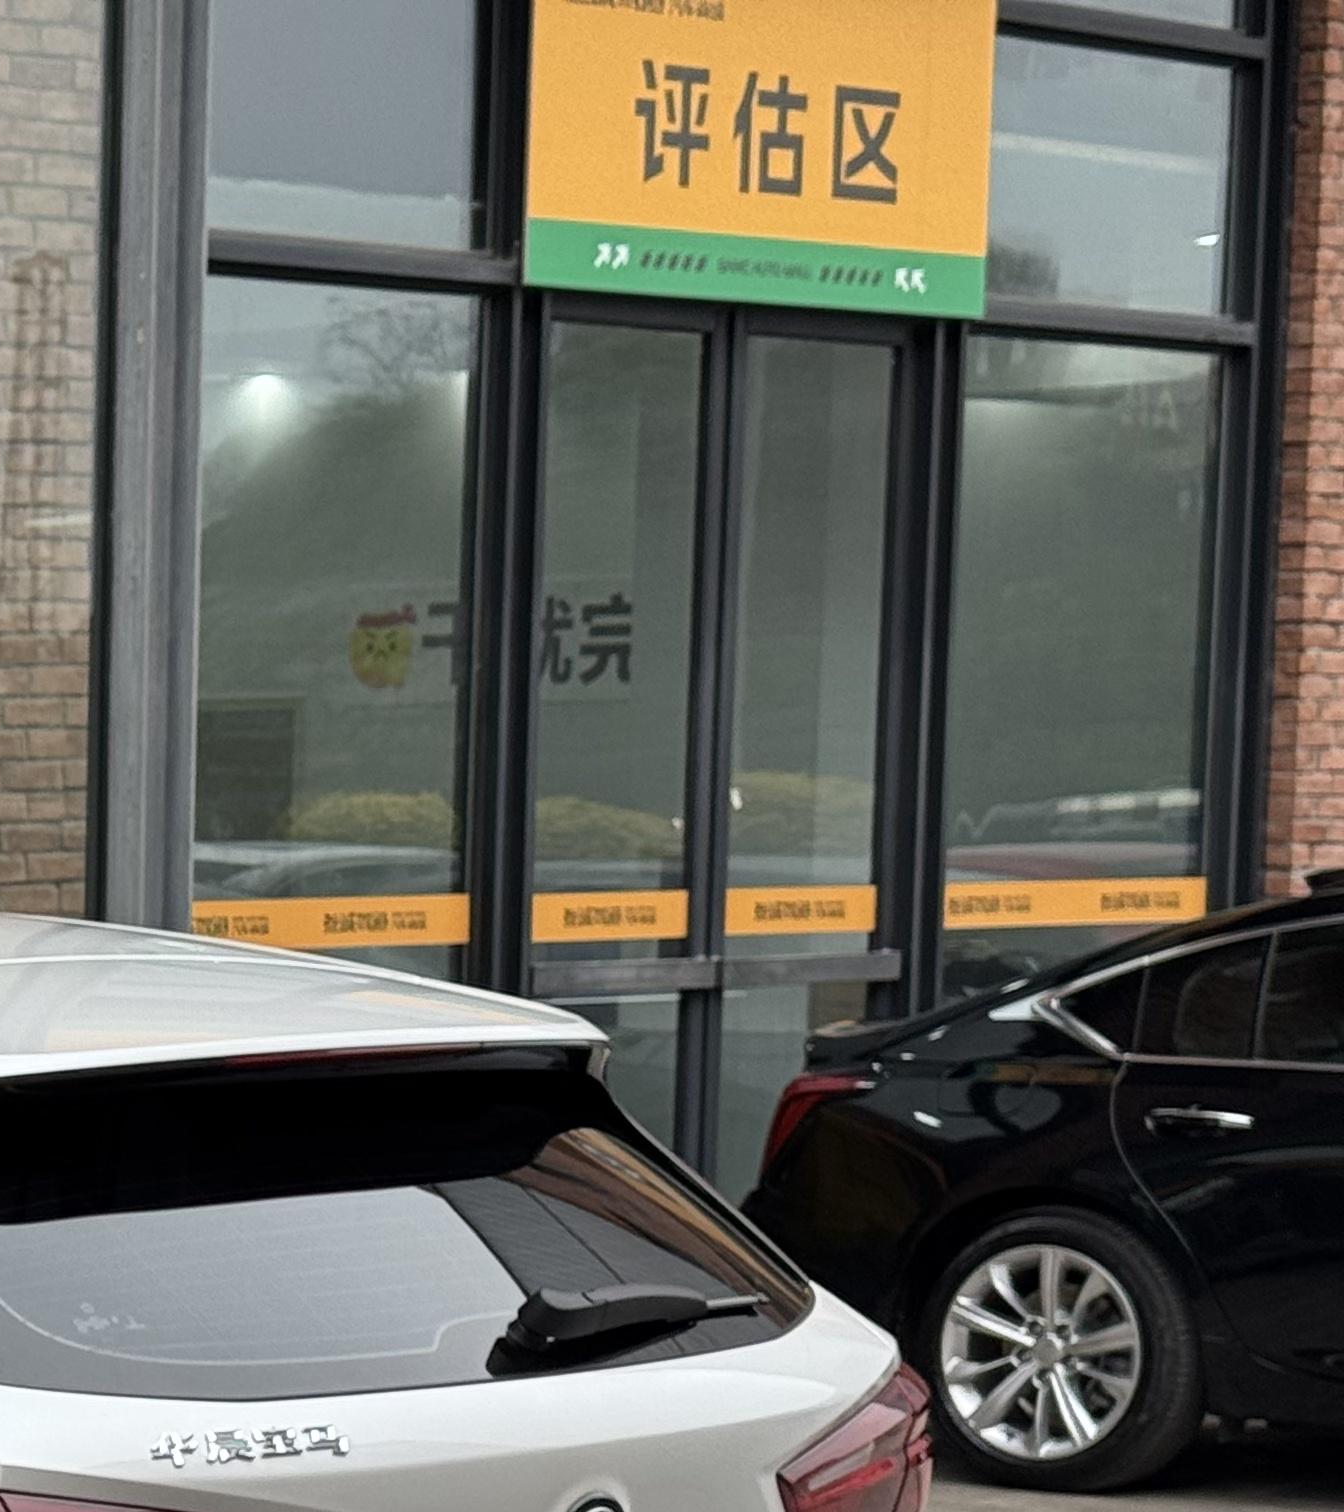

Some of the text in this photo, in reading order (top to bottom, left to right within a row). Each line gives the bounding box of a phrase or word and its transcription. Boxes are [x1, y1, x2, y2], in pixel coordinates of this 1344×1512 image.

[635, 59, 901, 205] 评估区
[150, 1424, 350, 1468] 华晨宝马
